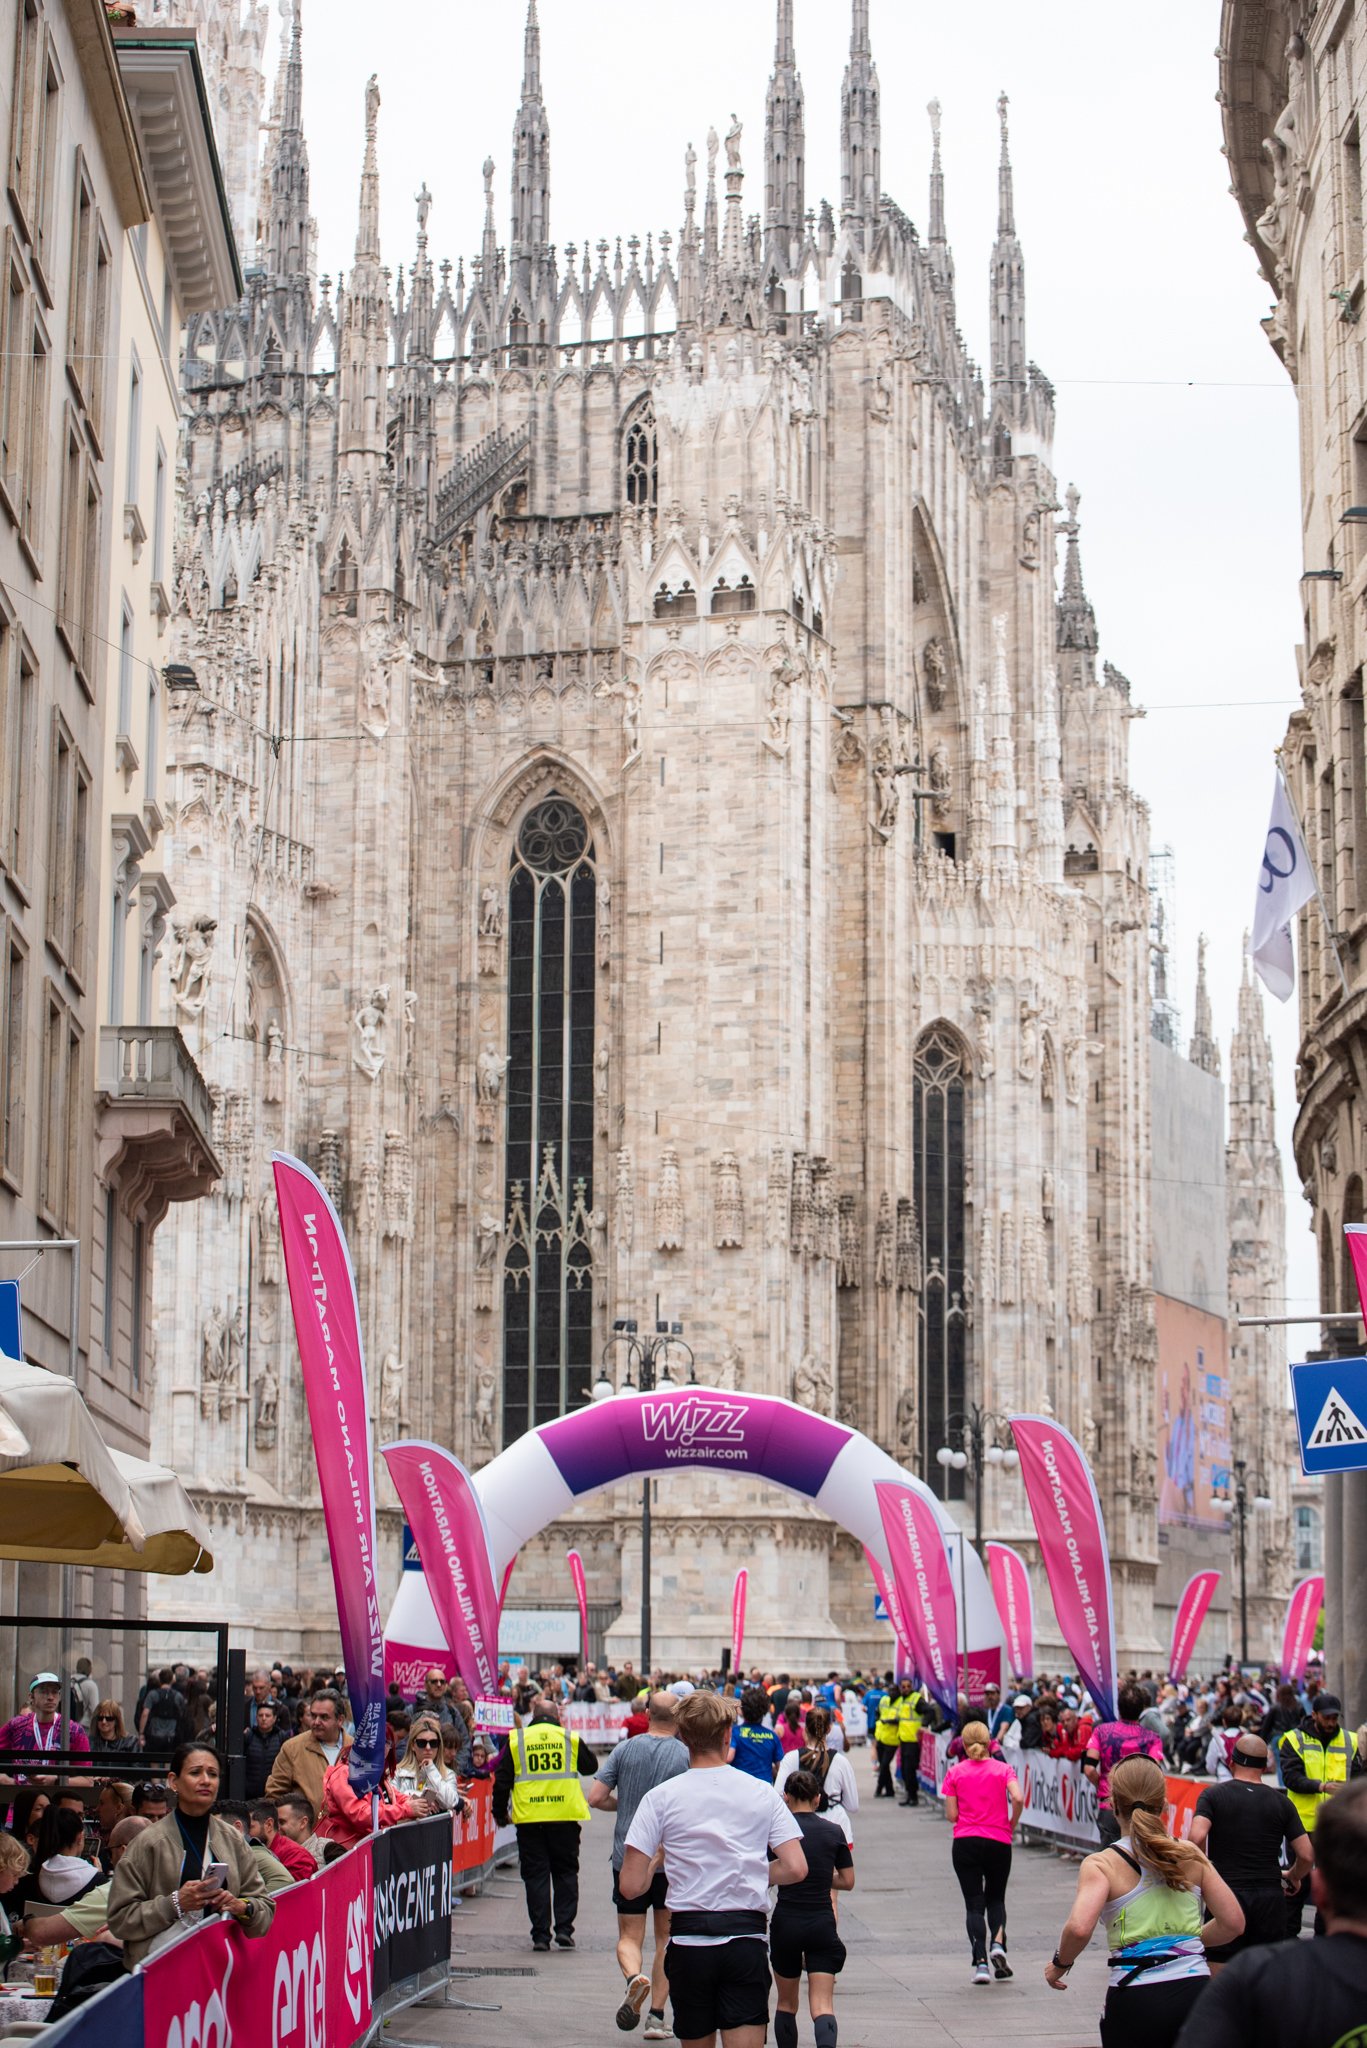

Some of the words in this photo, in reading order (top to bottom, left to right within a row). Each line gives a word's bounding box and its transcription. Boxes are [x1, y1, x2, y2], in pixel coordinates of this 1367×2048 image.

[665, 1447, 748, 1480] wizzair.com
[526, 1620, 566, 1633] NORD
[526, 1742, 563, 1751] ASSISTENZA
[528, 1752, 562, 1772] 033
[344, 1855, 373, 2025] enl
[272, 1888, 327, 2048] enel
